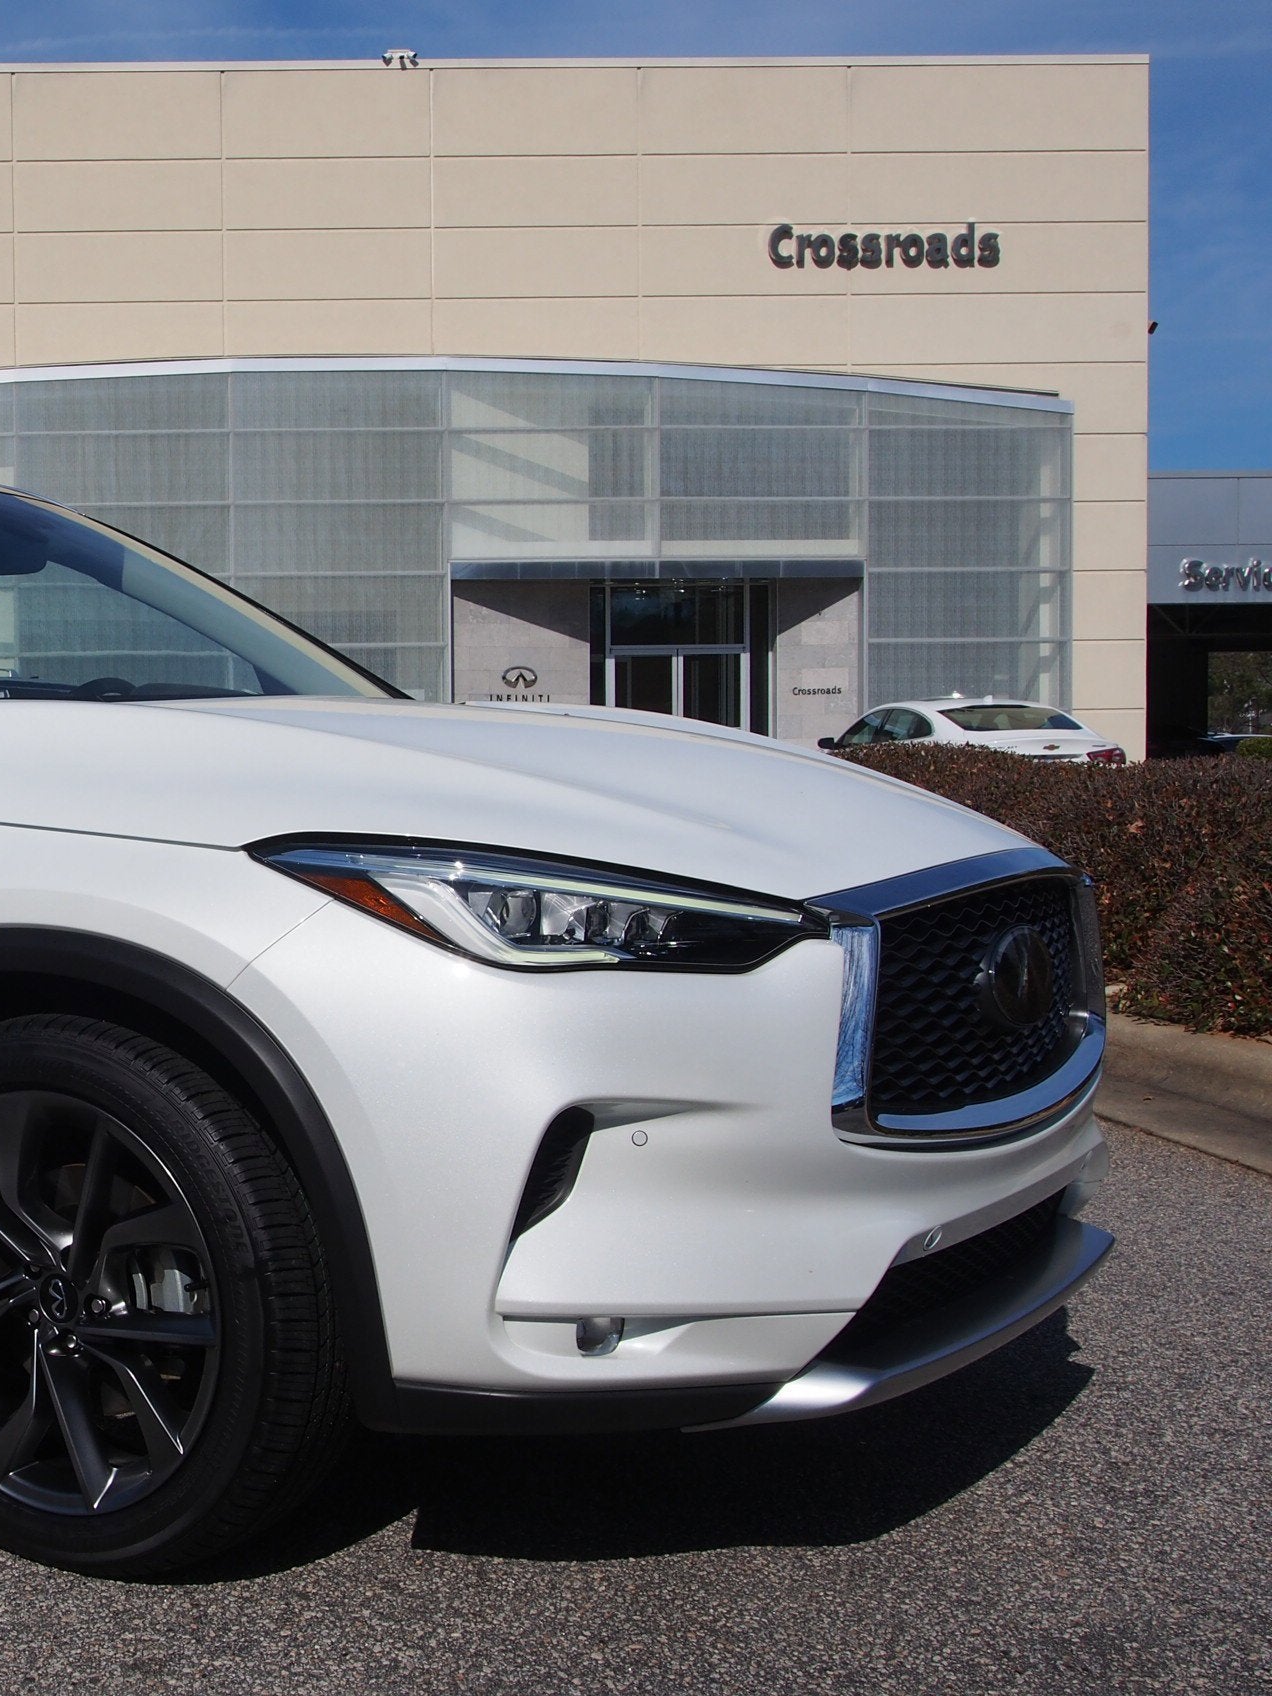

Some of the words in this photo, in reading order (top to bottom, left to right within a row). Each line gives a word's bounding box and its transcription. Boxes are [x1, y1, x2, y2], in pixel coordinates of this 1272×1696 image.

[768, 222, 1001, 270] Crossroads
[792, 685, 842, 696] Crossroads
[489, 694, 550, 702] INFINITI
